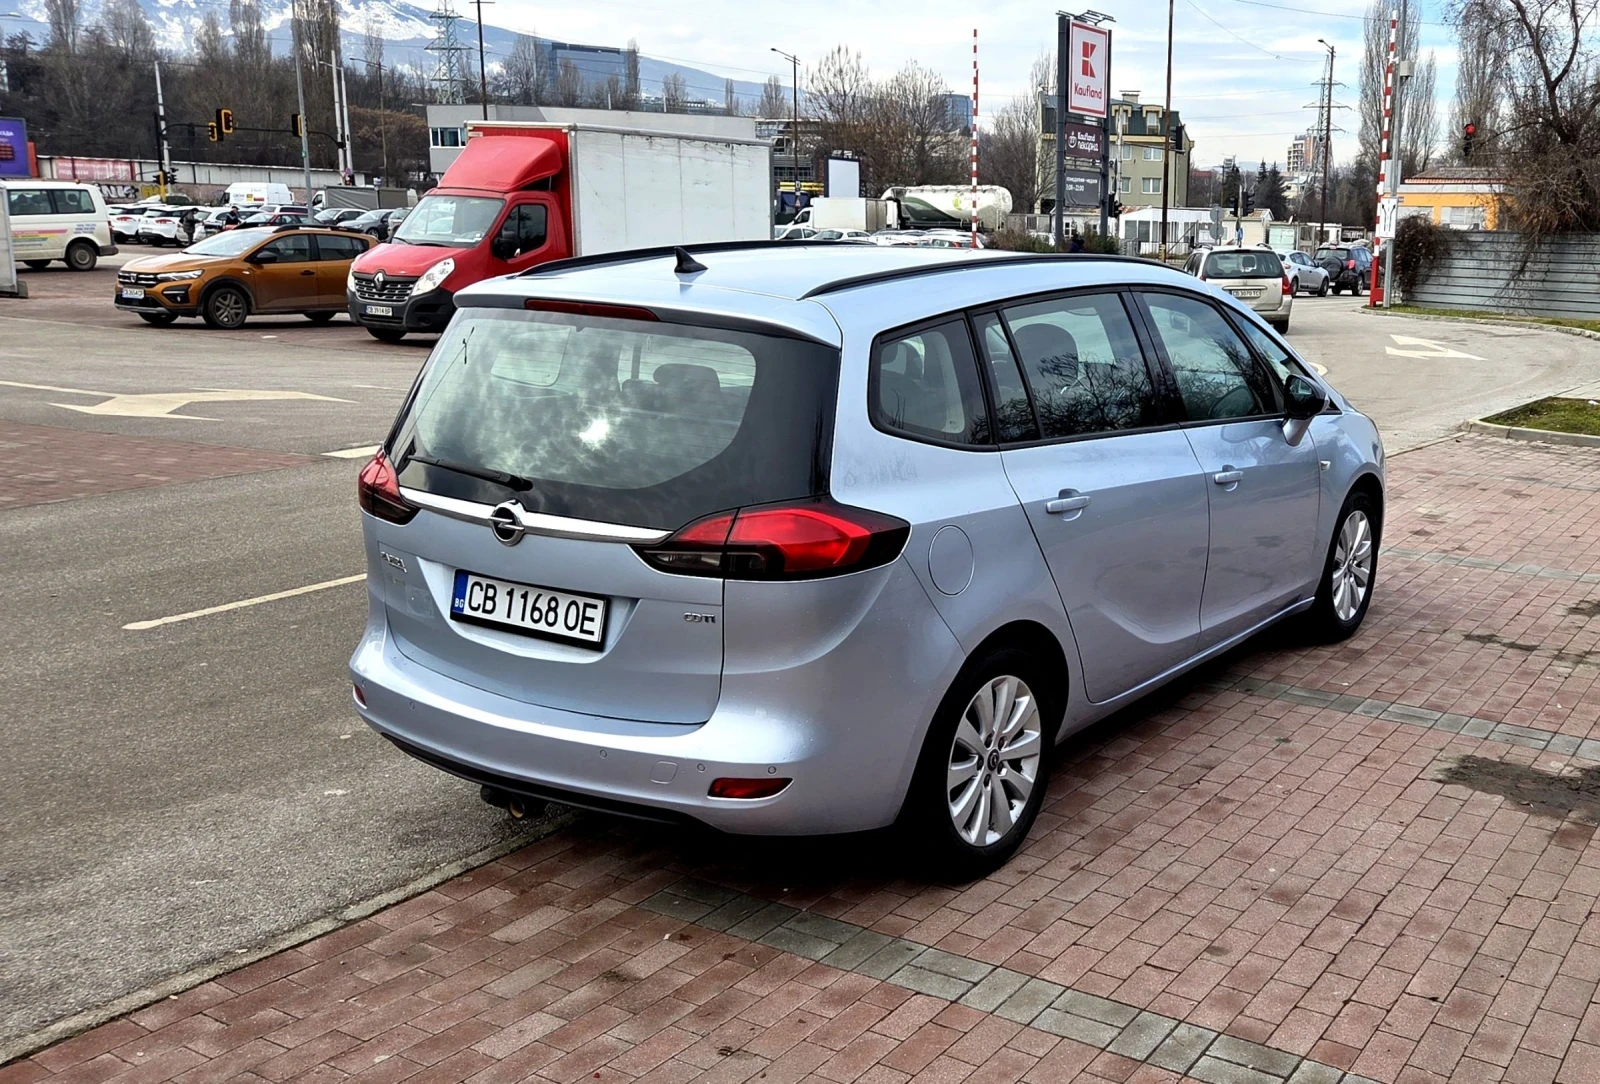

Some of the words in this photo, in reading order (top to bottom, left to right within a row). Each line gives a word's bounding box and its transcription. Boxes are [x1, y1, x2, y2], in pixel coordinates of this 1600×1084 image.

[1074, 82, 1102, 99] Kaufland
[1077, 131, 1096, 142] Kaufland
[454, 598, 464, 608] BG
[468, 581, 497, 615] CB
[506, 587, 559, 627] 1168
